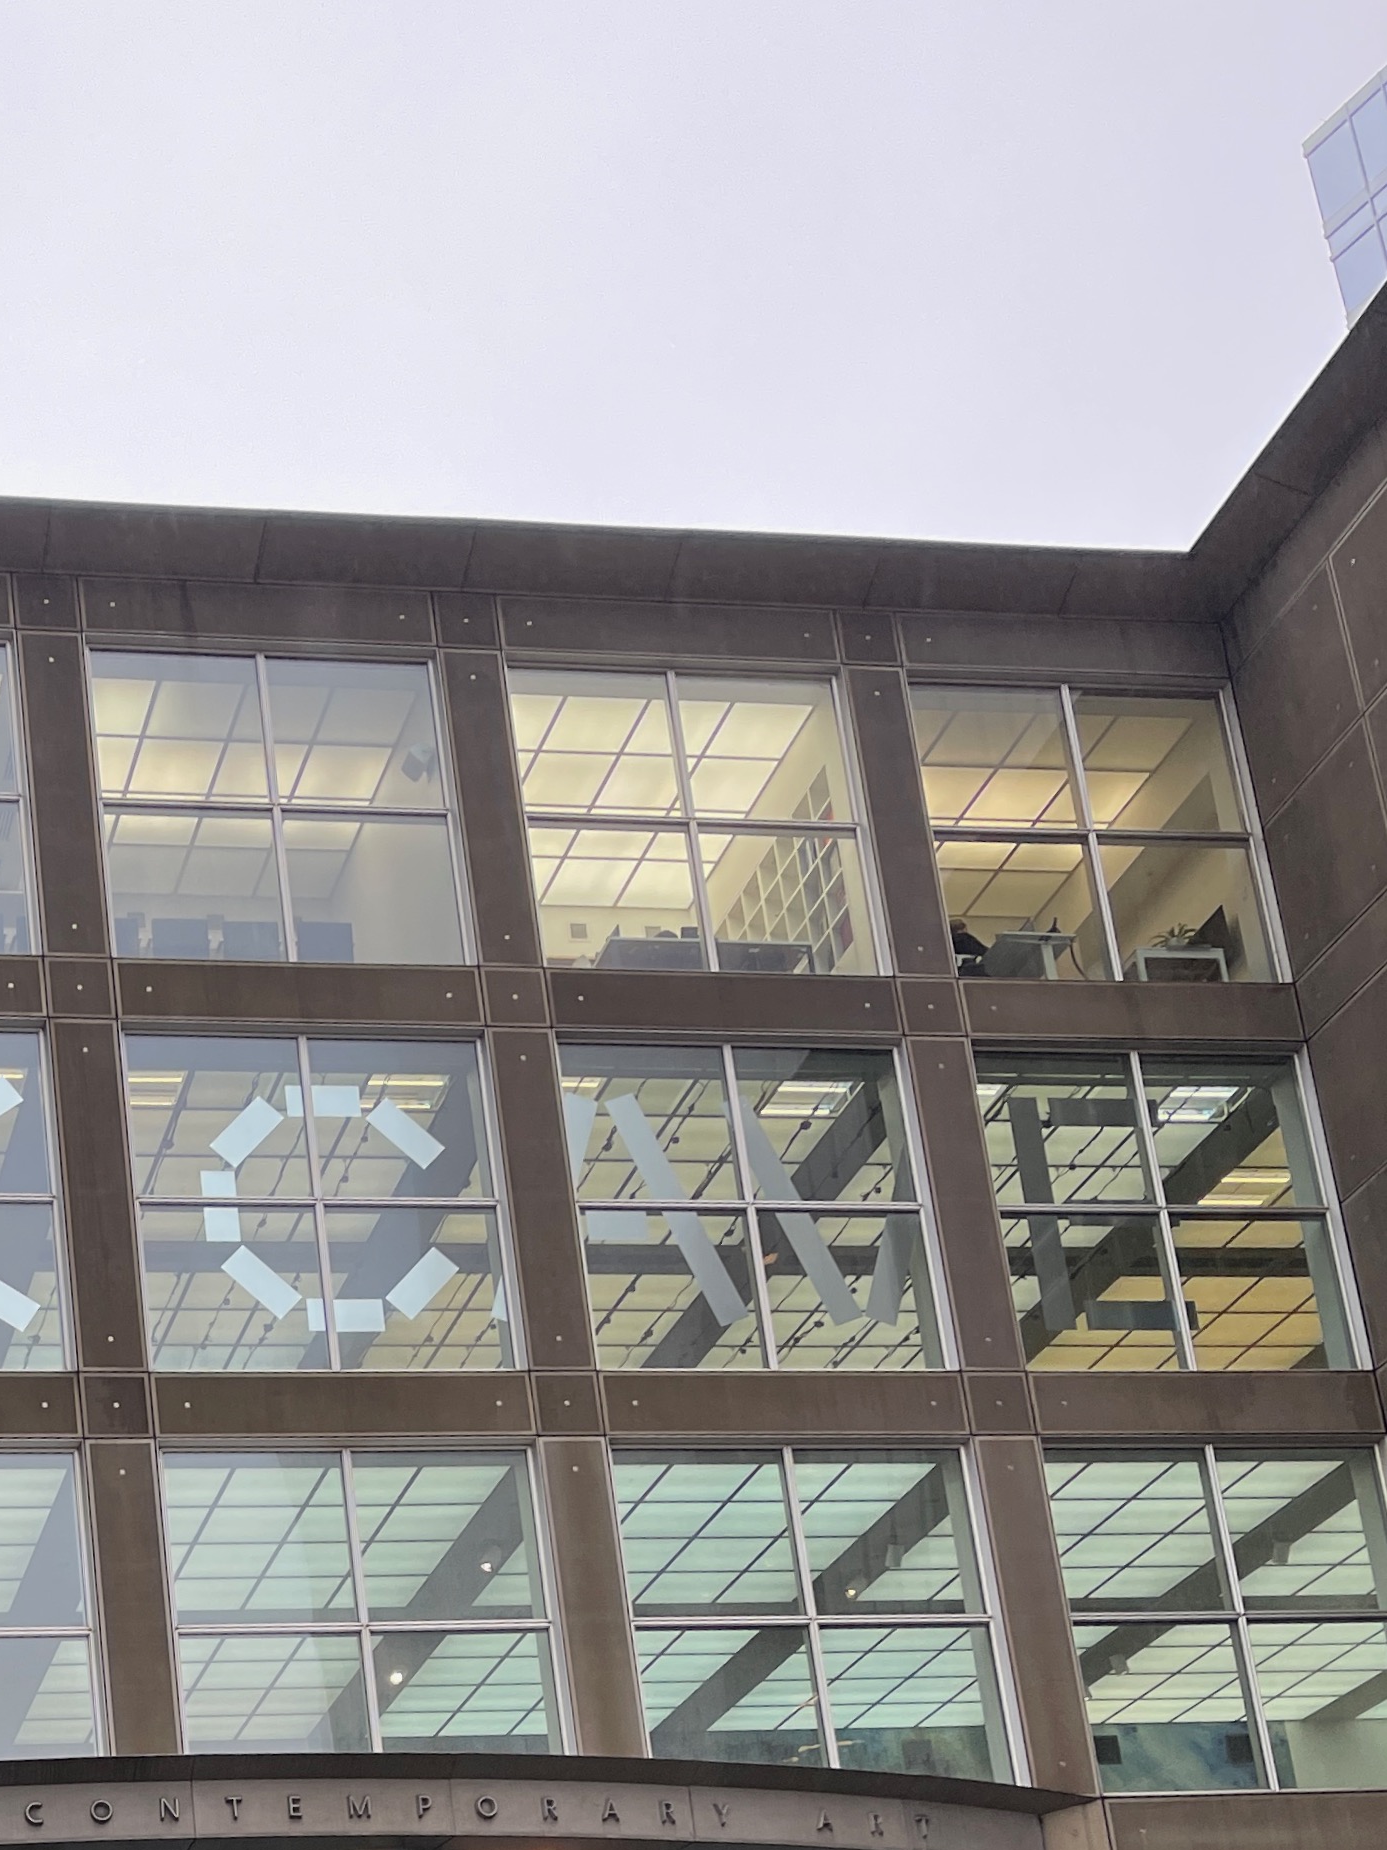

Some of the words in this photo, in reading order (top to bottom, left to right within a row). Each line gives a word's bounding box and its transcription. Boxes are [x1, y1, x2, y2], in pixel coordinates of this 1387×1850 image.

[200, 1084, 1199, 1331] CAVE
[24, 1794, 730, 1828] CONTEMPORARY
[816, 1809, 930, 1840] ART
